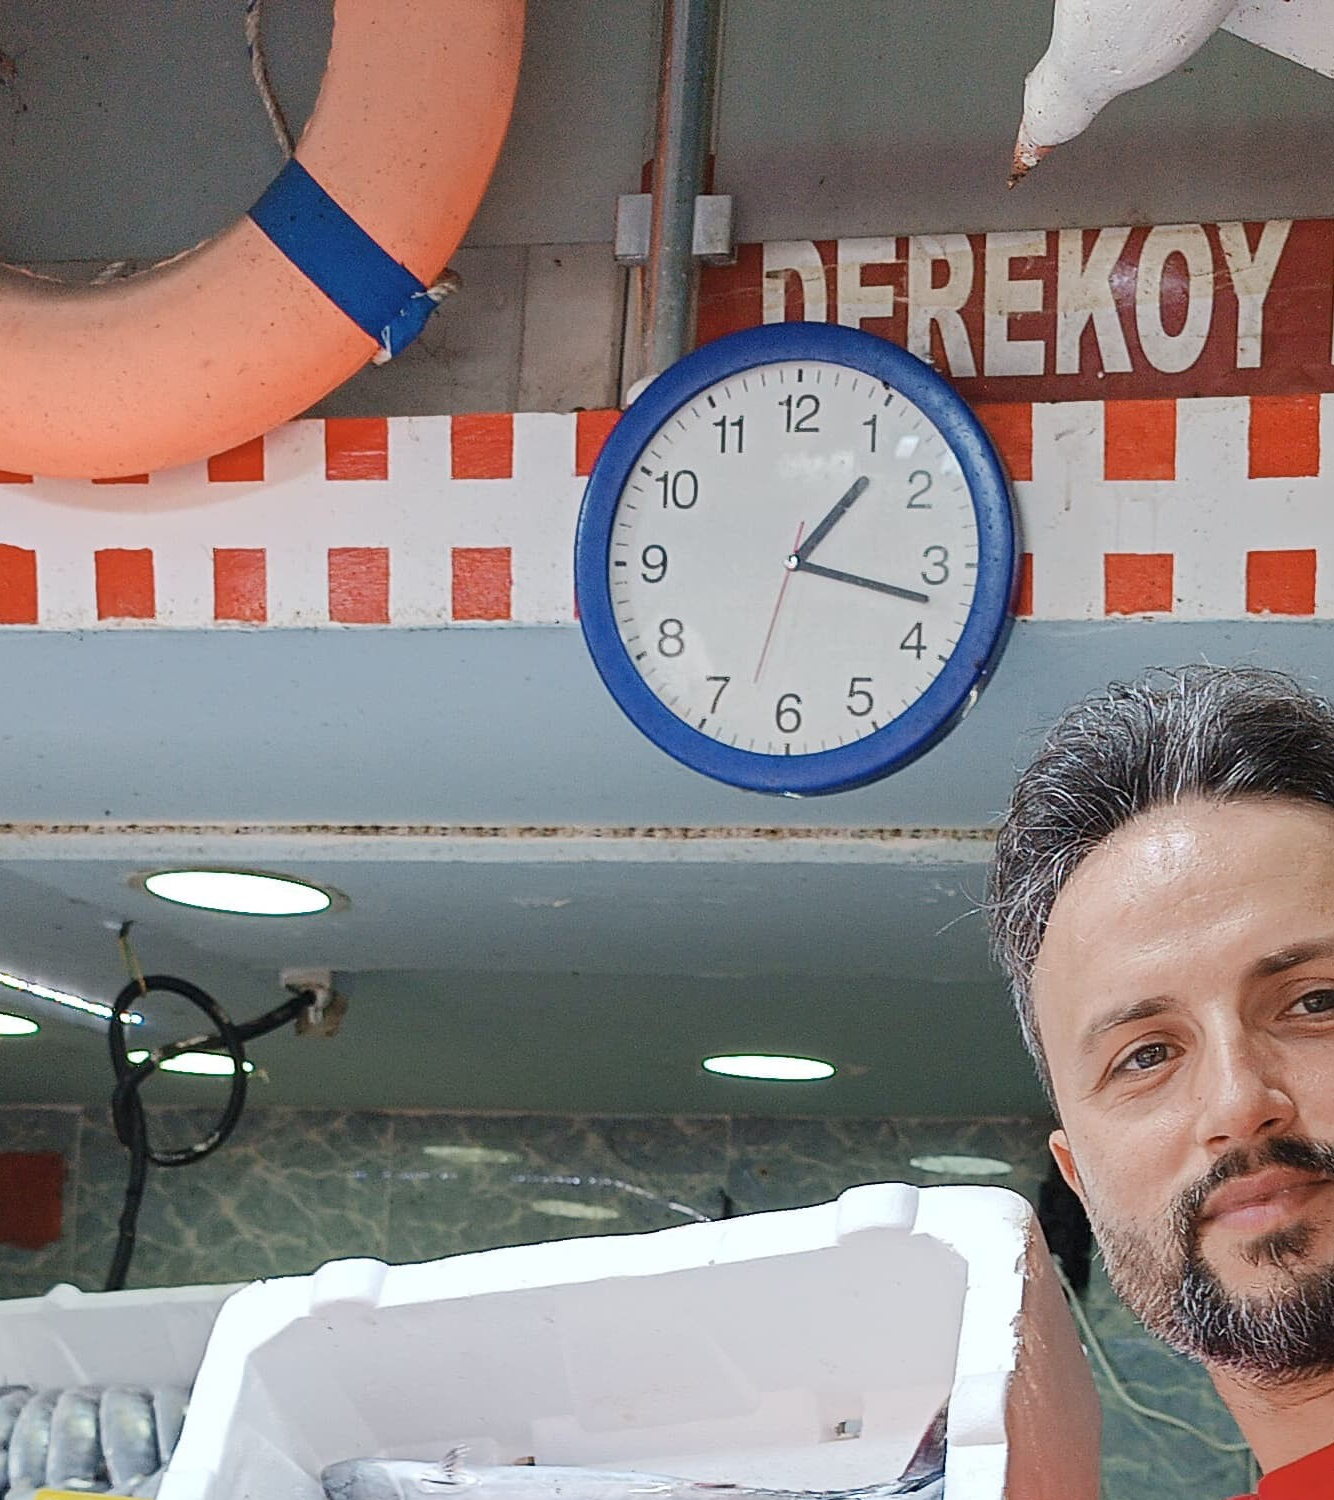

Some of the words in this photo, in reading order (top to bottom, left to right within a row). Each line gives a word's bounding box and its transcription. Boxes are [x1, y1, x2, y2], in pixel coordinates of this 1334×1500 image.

[778, 394, 820, 433] 12
[862, 413, 878, 453] 1
[713, 414, 746, 454] 11
[654, 469, 699, 510] 10
[906, 470, 933, 509] 2
[641, 544, 669, 584] 9
[921, 545, 949, 585] 3
[657, 618, 685, 658] 8
[899, 622, 928, 661] 4
[705, 675, 731, 714] 7
[775, 693, 803, 733] 6
[846, 676, 874, 717] 5
